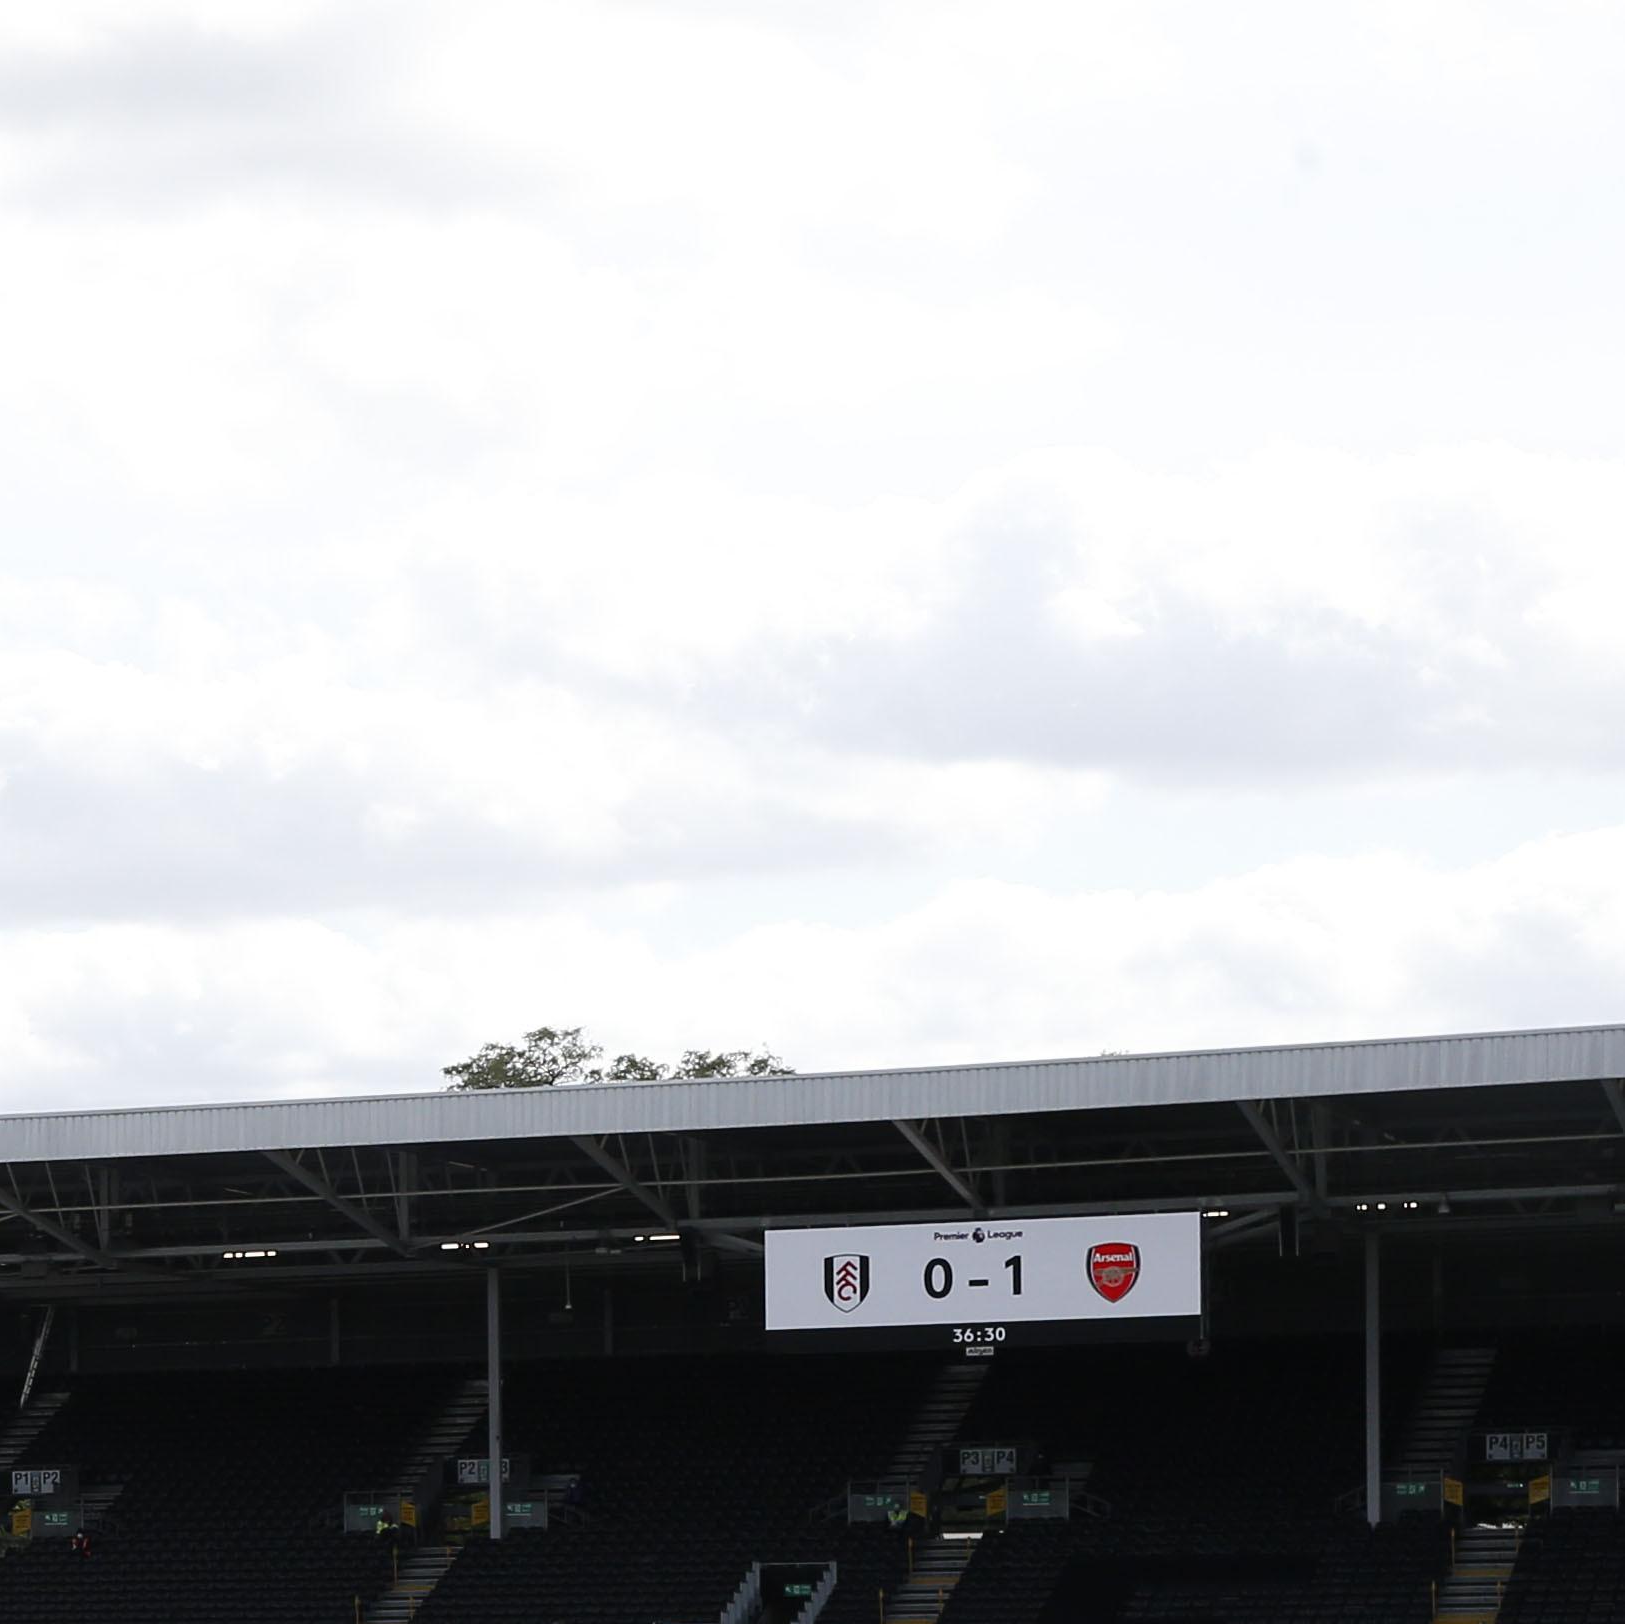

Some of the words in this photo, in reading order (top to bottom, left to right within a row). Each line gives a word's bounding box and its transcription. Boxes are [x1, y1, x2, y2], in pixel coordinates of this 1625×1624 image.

[934, 1231, 969, 1241] Premier
[987, 1230, 1023, 1241] League
[1094, 1252, 1133, 1264] Arsenal
[923, 1257, 953, 1299] 0
[1004, 1255, 1022, 1296] 1
[952, 1326, 1007, 1343] 36:30
[1488, 1435, 1508, 1450] P4
[1525, 1435, 1546, 1450] P5
[961, 1451, 980, 1465] P3
[996, 1450, 1014, 1465] P4
[458, 1460, 475, 1477] P2
[14, 1472, 29, 1486] P1
[42, 1471, 61, 1485] P2
